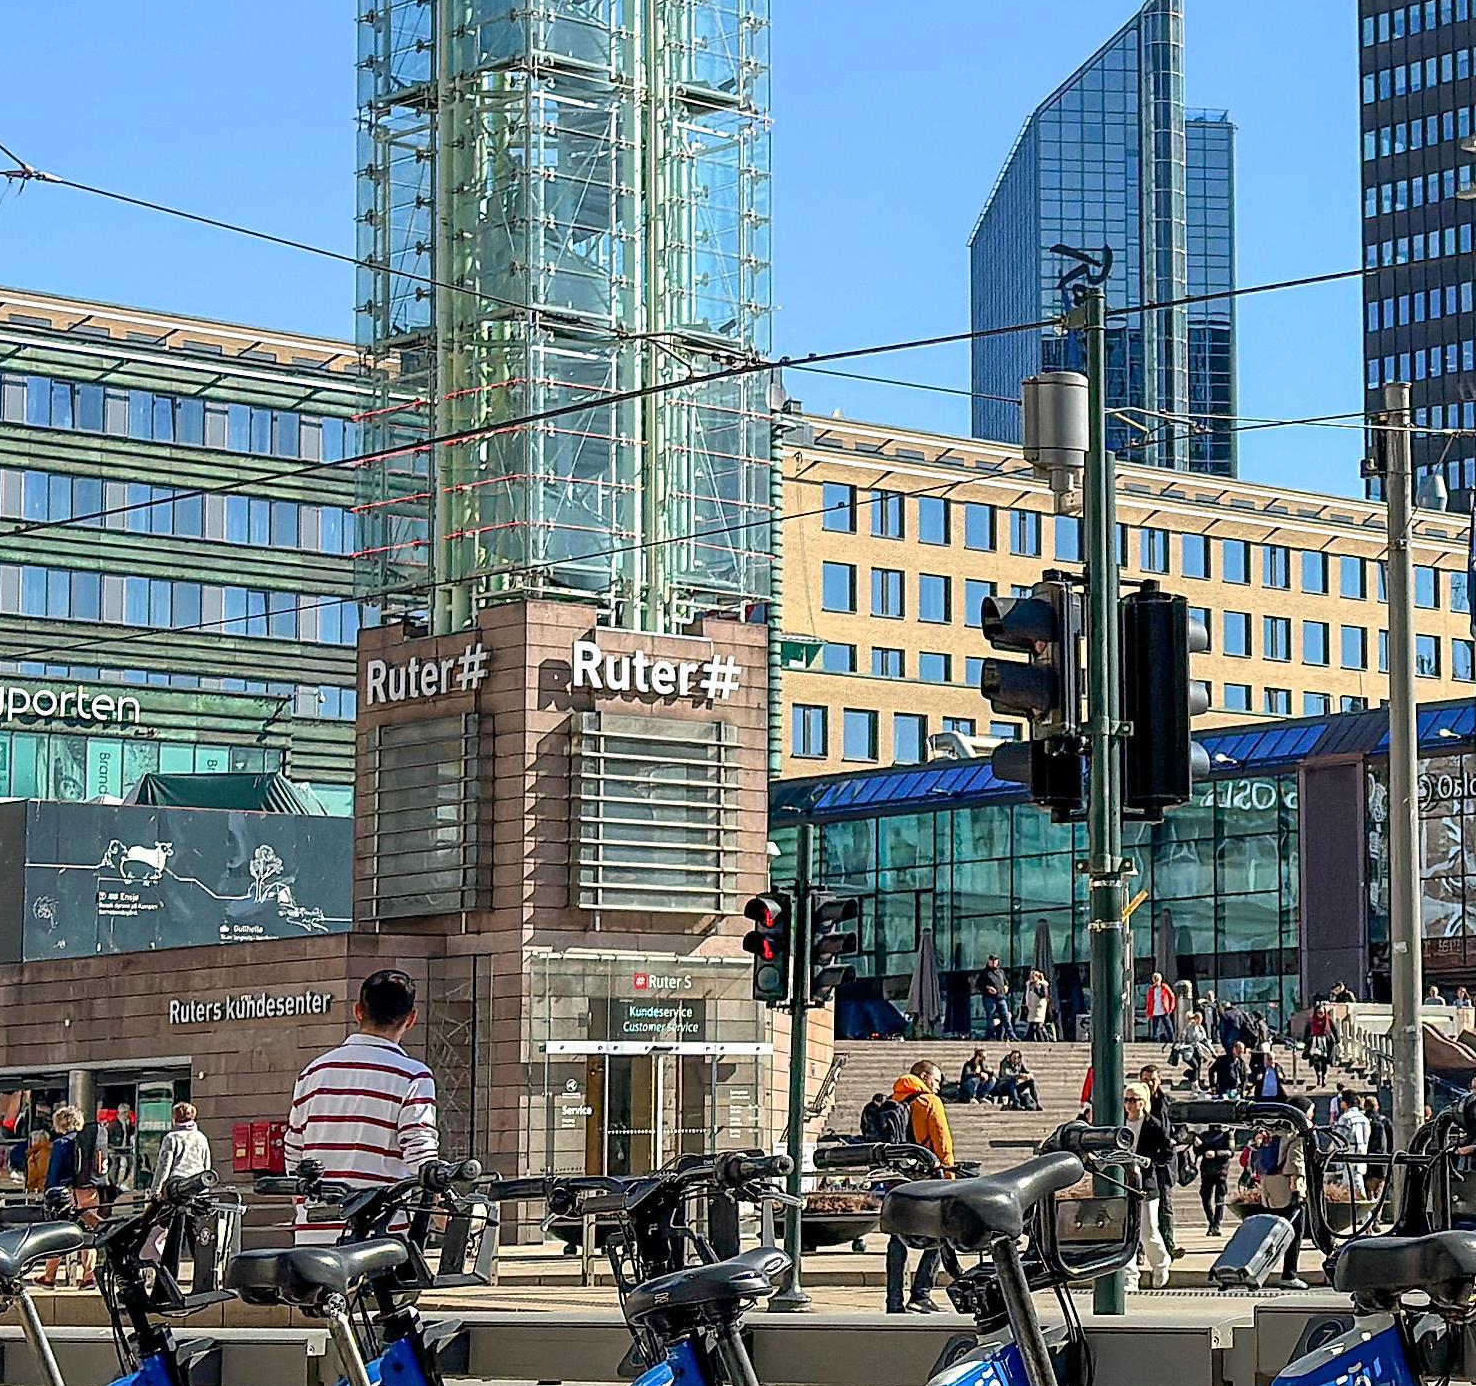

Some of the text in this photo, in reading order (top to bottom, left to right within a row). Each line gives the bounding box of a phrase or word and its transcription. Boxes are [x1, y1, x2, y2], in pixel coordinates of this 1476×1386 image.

[367, 643, 489, 706] Ruter#
[573, 640, 743, 700] Ruter#
[648, 974, 682, 990] Ruter
[169, 991, 332, 1024] Ruters kundesenter
[629, 1005, 693, 1019] Kundeservice
[623, 1021, 666, 1033] Customer
[561, 1105, 592, 1116] Service
